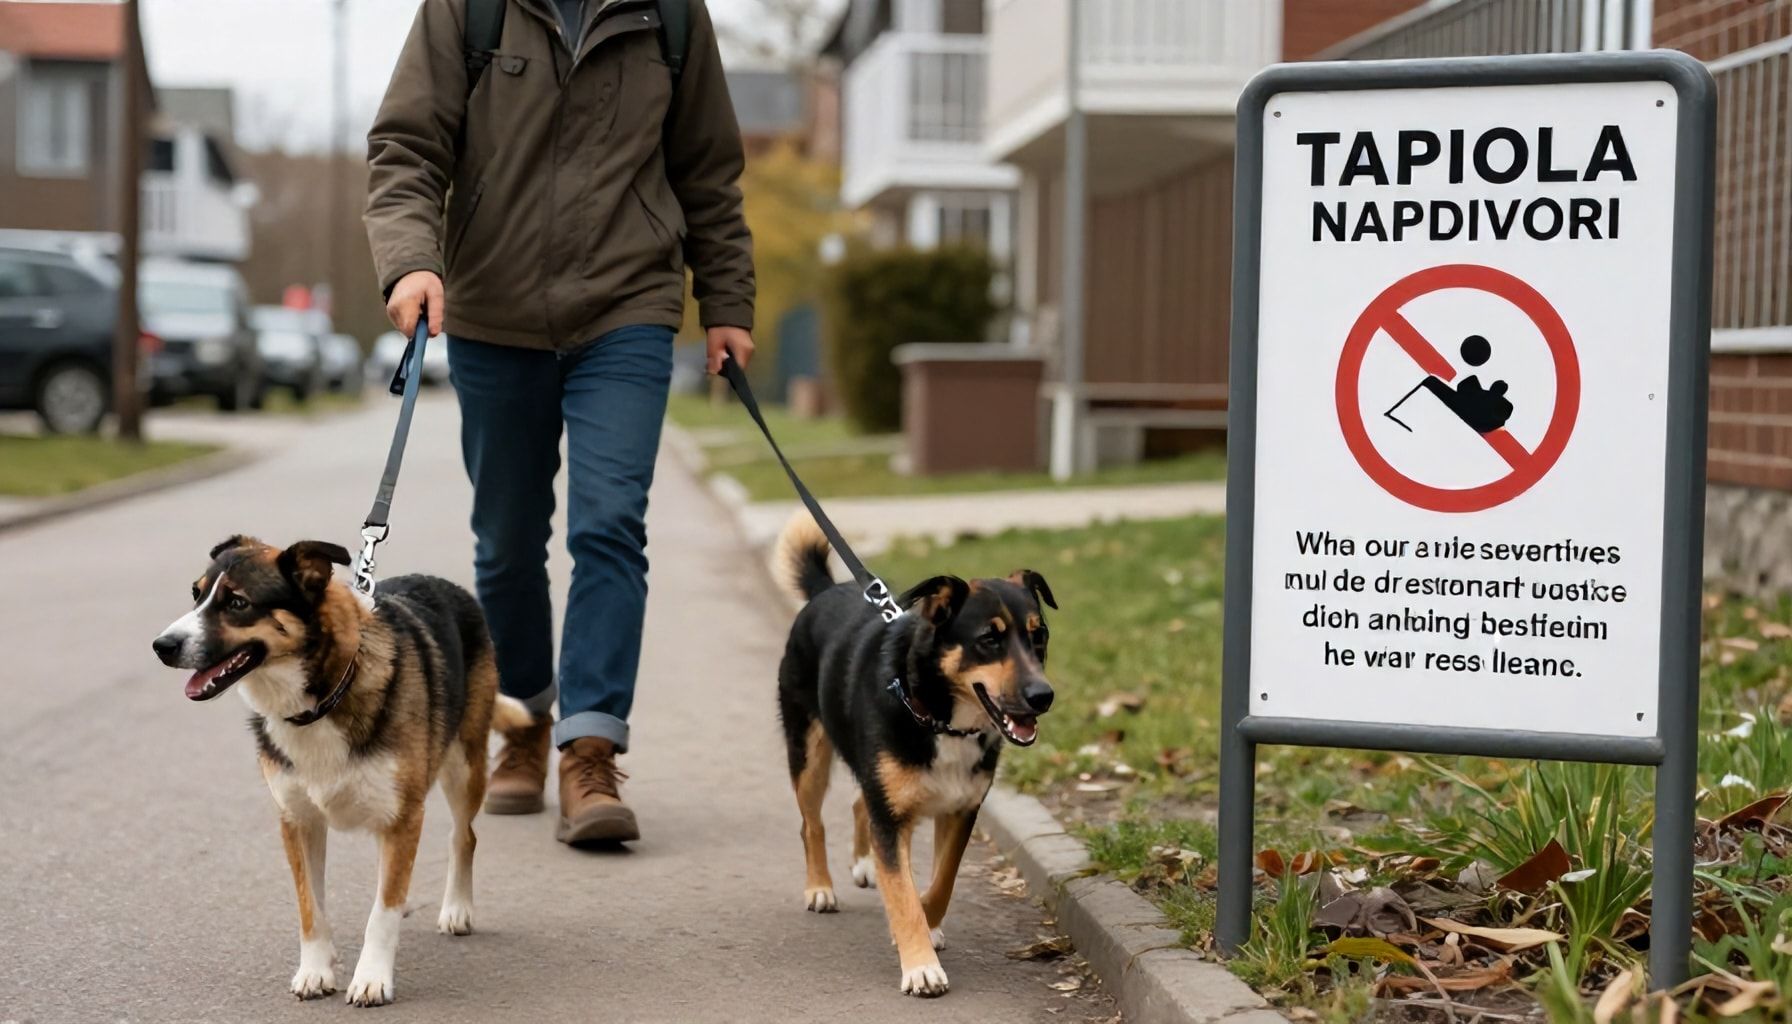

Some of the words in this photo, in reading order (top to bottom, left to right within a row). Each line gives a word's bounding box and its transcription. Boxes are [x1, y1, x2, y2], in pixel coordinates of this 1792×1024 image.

[1296, 124, 1638, 187] TAPIOLA
[1312, 196, 1620, 242] NAPDIVORI
[1296, 530, 1355, 557] Wha
[1365, 539, 1410, 558] our
[1324, 641, 1356, 667] he
